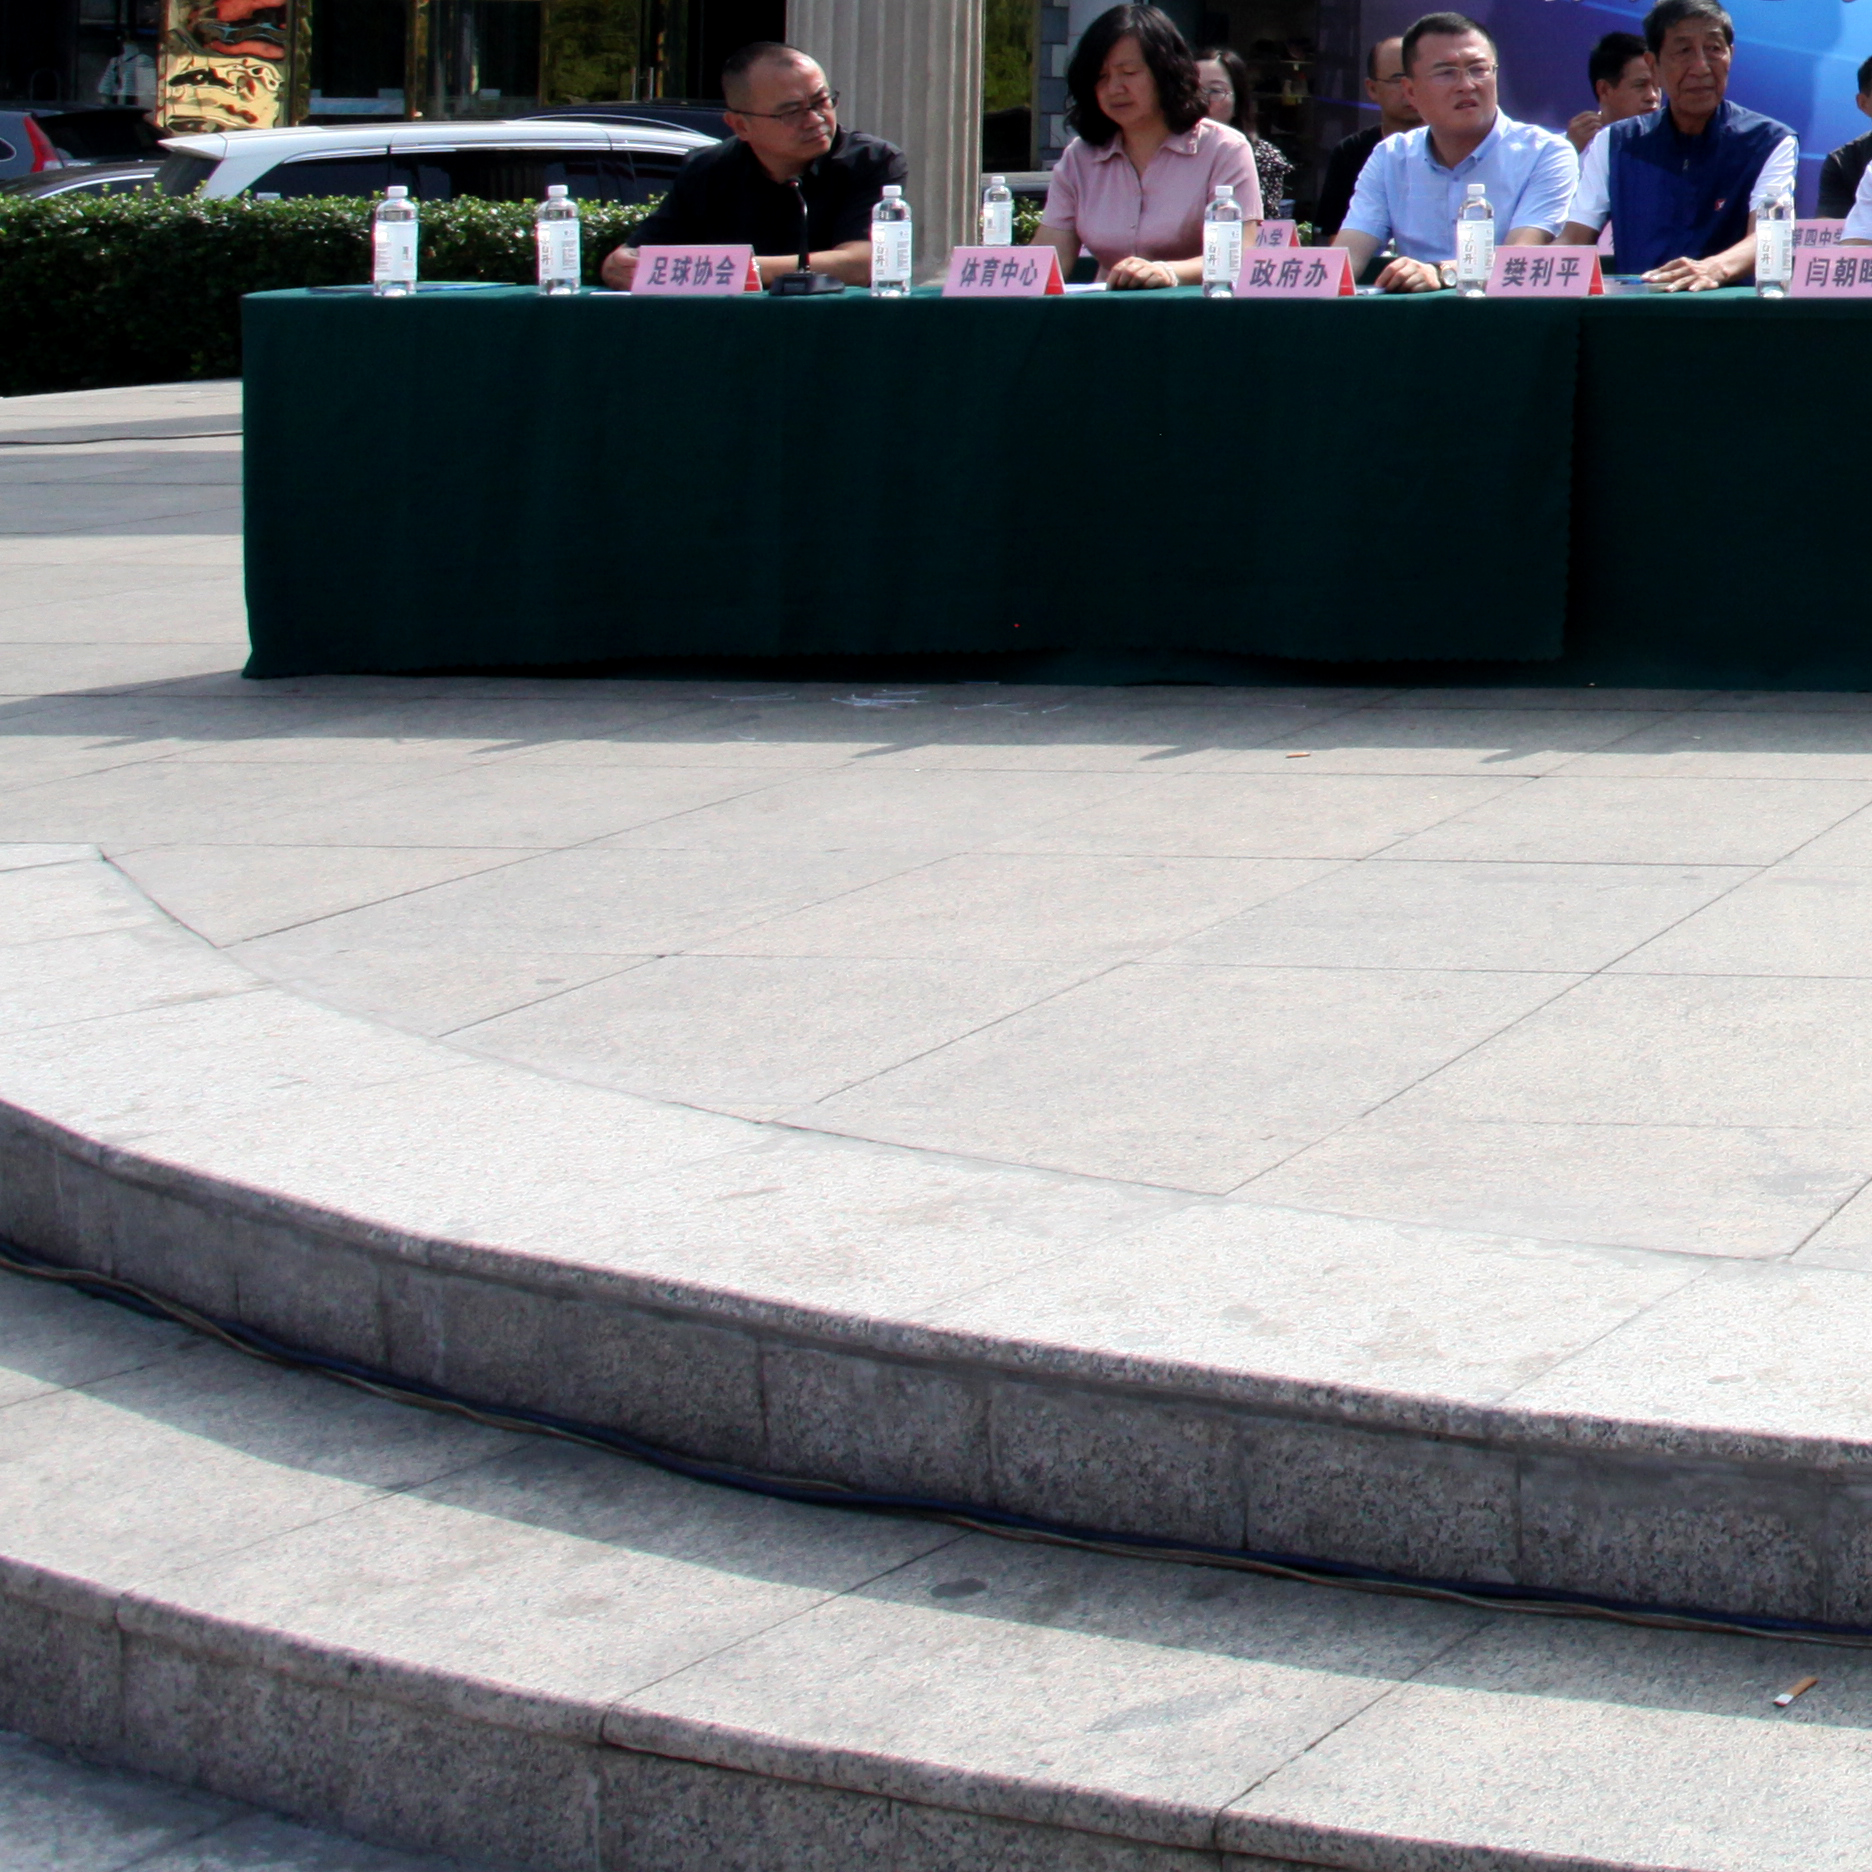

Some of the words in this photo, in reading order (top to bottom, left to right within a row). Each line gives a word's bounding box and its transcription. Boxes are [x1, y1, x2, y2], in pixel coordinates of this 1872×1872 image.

[646, 256, 737, 288] 足球协会
[959, 257, 1039, 289] 体育中心
[1249, 259, 1330, 289] 政府办
[1501, 256, 1581, 288] 樊利平
